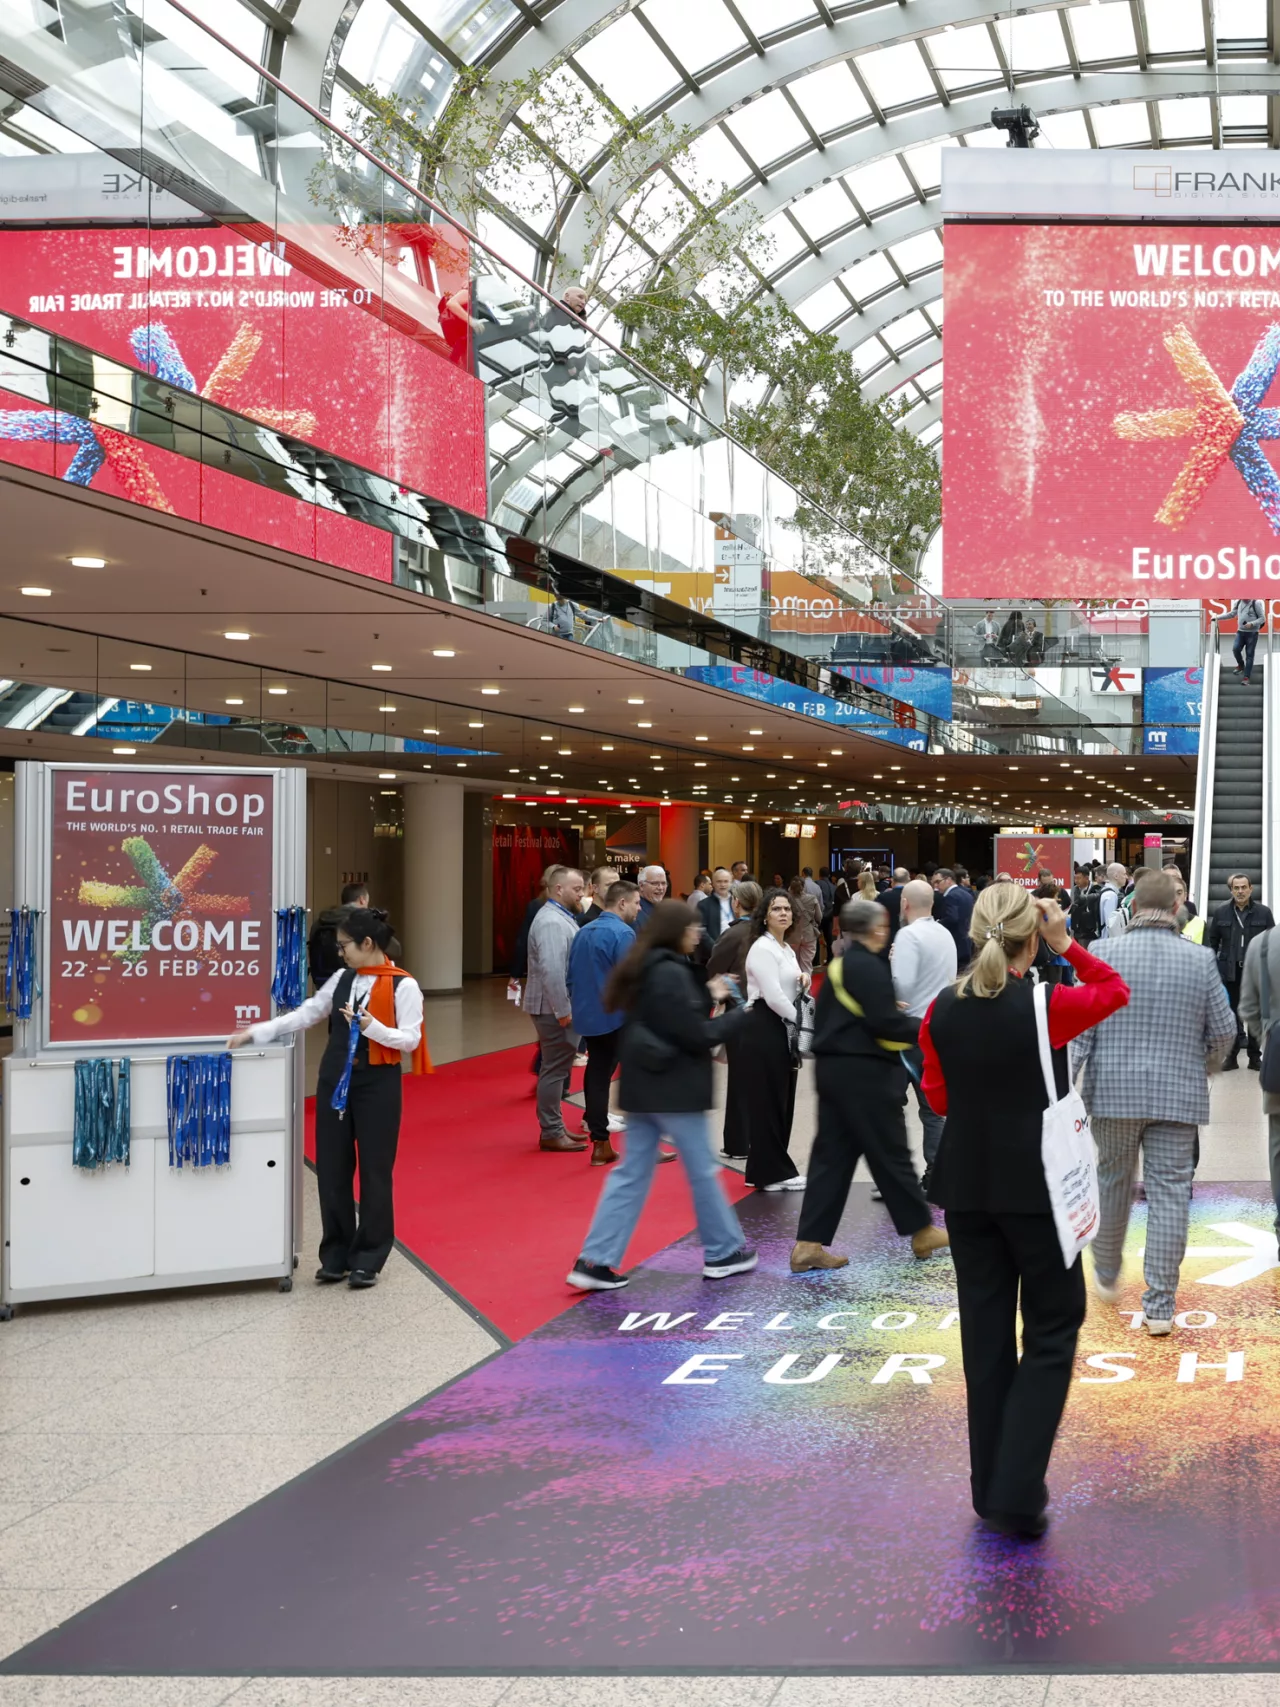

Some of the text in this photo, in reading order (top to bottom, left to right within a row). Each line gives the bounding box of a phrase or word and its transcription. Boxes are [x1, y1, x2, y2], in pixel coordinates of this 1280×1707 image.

[1043, 290, 1065, 308] TO
[1070, 290, 1104, 308] THE
[1109, 290, 1188, 308] WORLD'S
[1194, 291, 1233, 308] NO.1
[66, 780, 265, 824] EuroShop
[66, 822, 87, 831] THE
[90, 823, 137, 833] WORLD'S
[140, 824, 158, 834] NO.
[170, 825, 204, 834] RETAIL
[207, 826, 238, 835] TRADE
[241, 826, 264, 836] FAIR
[514, 834, 543, 848] Festival
[543, 836, 560, 848] 2026
[614, 853, 640, 862] make
[62, 919, 261, 951] WELCOME
[61, 961, 86, 977] 22
[122, 960, 148, 977] 26
[159, 960, 198, 976] FEB
[208, 960, 260, 976] 2026
[1119, 1310, 1218, 1329] TO
